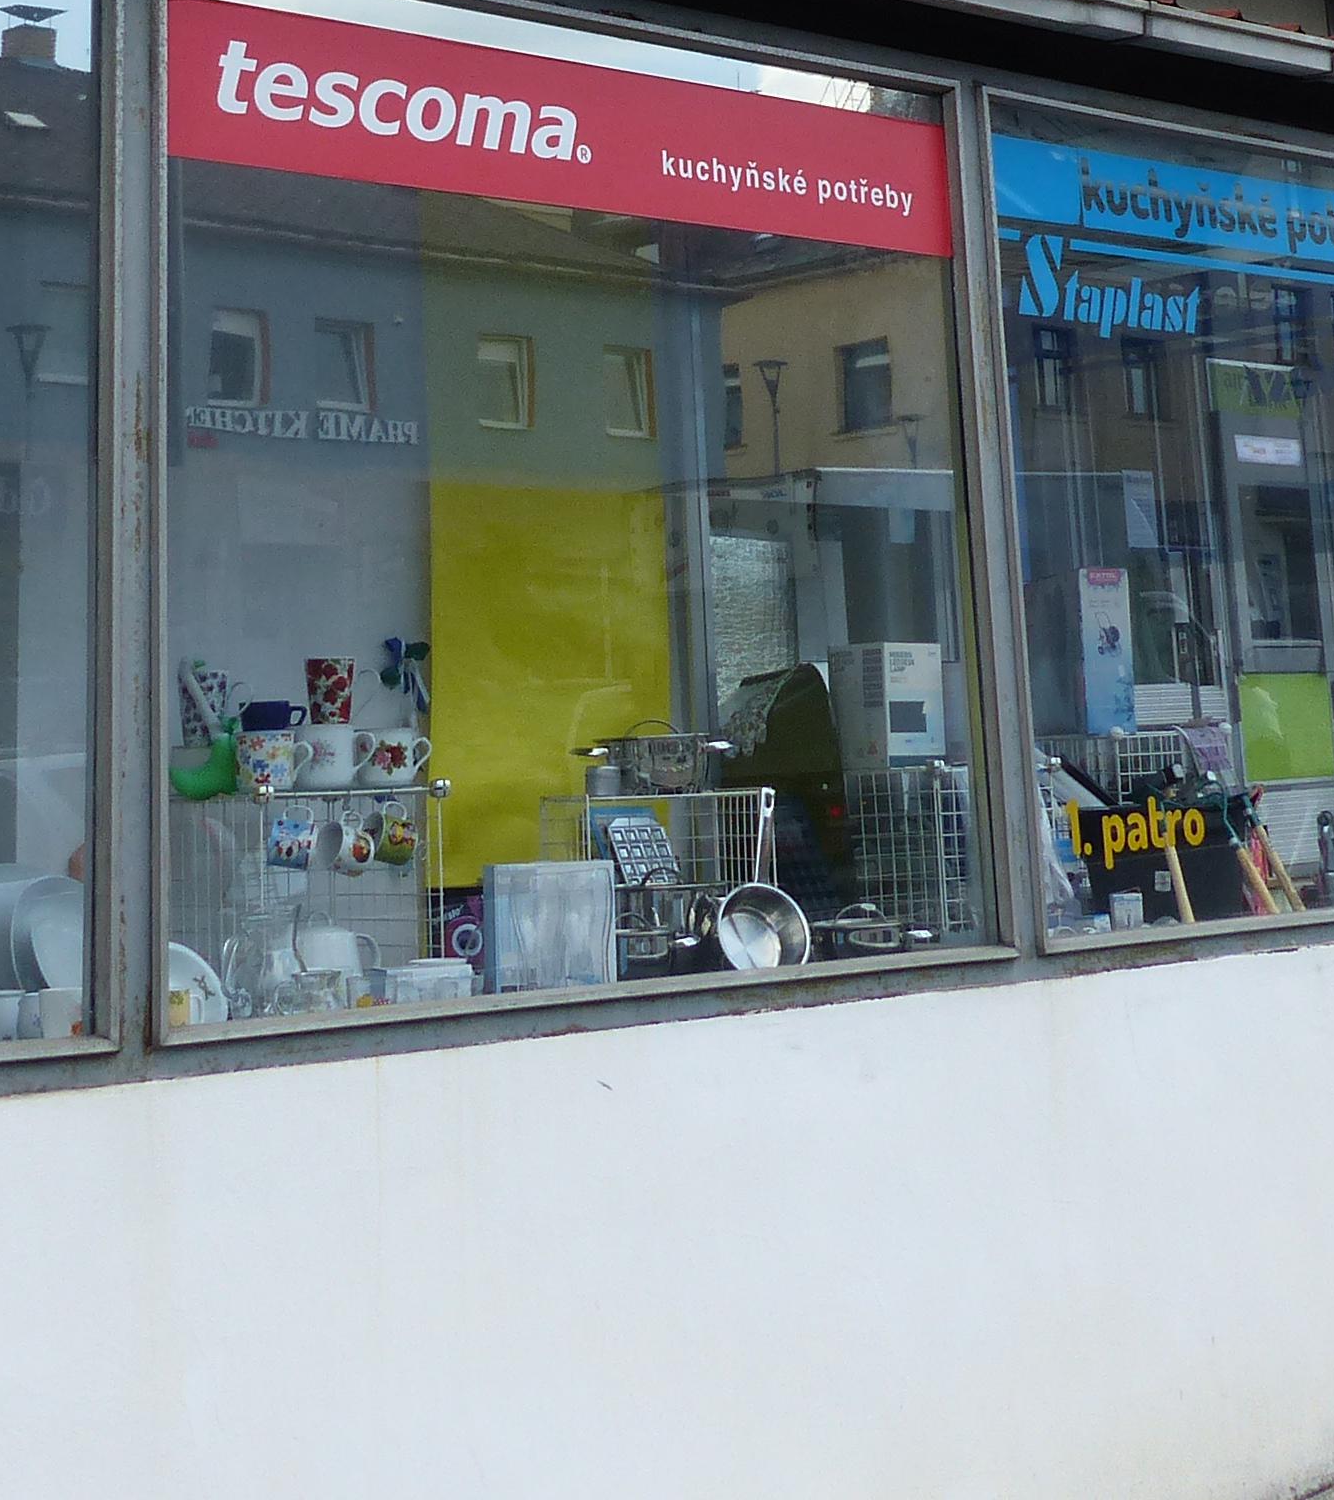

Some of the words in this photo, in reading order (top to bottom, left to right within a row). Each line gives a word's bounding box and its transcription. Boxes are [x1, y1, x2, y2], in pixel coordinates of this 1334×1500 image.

[661, 149, 807, 195] kuchyňské
[817, 177, 913, 216] potřeby
[1079, 155, 1279, 239] kuchyňské
[1019, 233, 1201, 339] Staplast
[1065, 797, 1092, 857] 1.
[1101, 795, 1206, 870] patro
